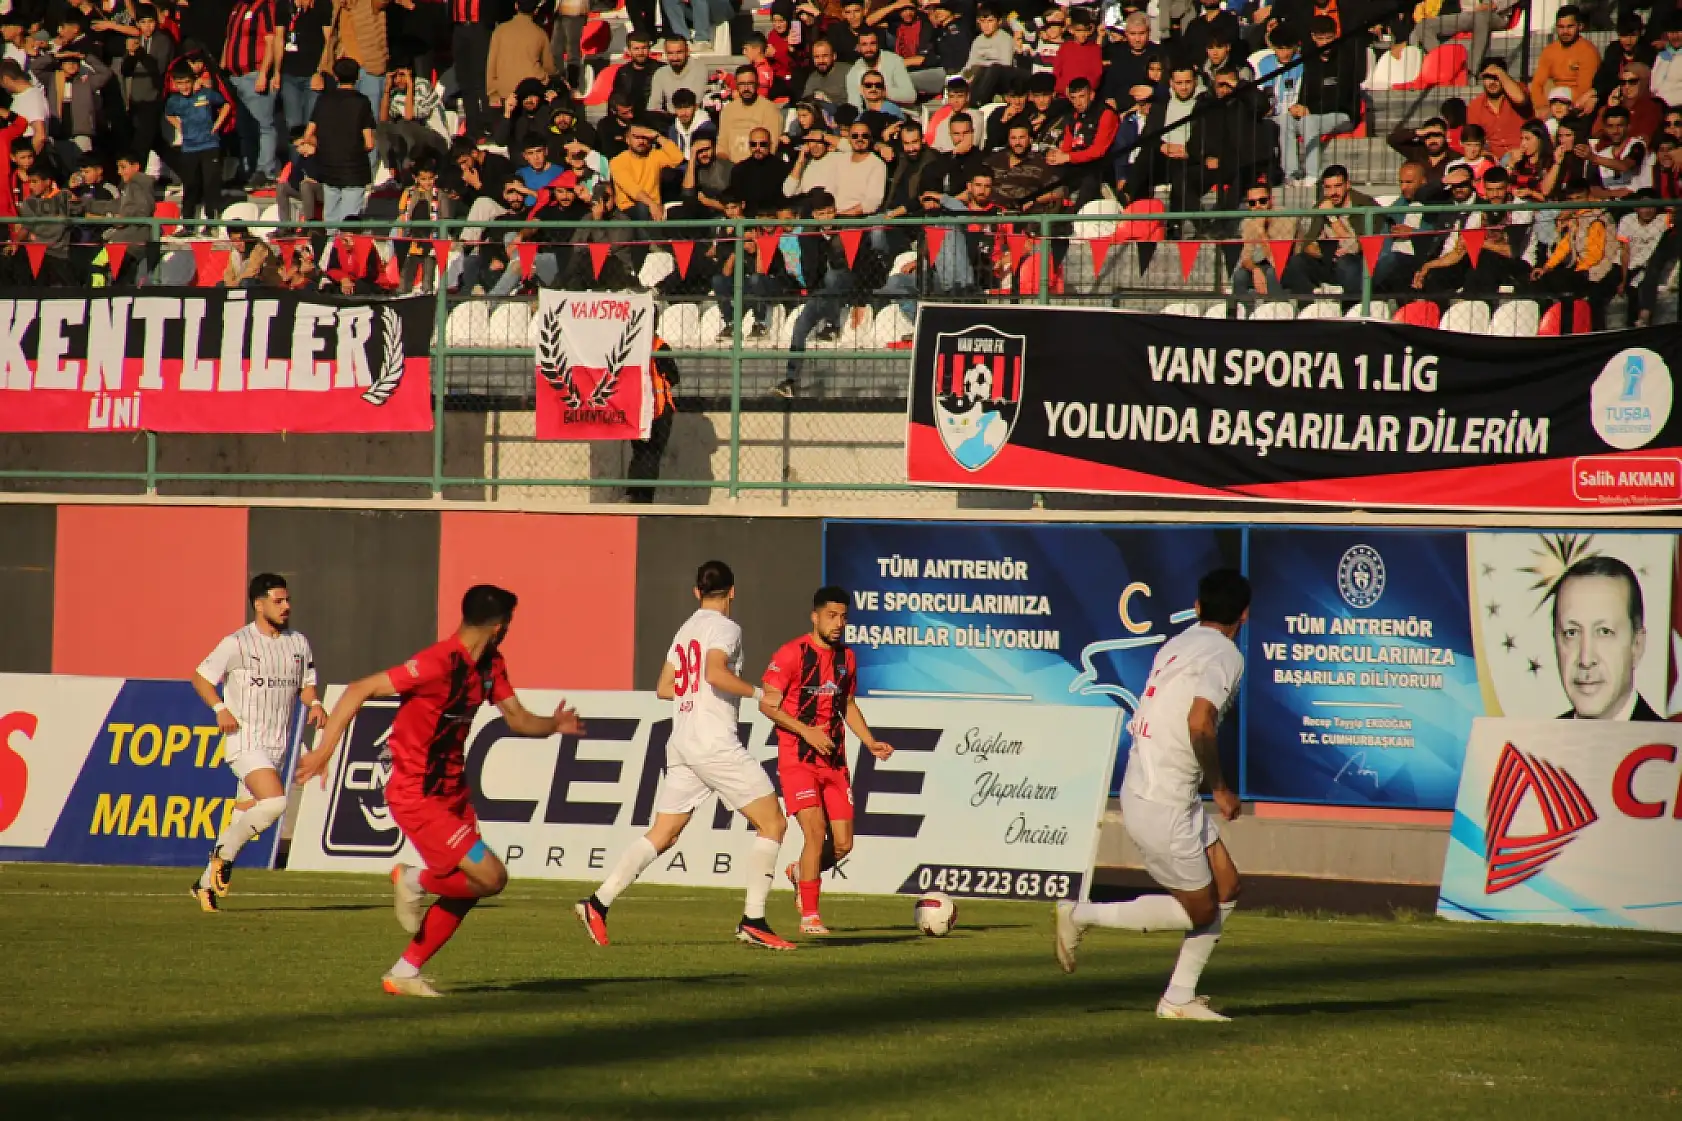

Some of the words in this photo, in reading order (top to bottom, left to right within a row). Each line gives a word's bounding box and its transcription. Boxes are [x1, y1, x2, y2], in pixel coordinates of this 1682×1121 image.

[1147, 345, 1216, 385] VAN
[1223, 348, 1344, 390] SPOR'A
[1354, 346, 1440, 393] 1.LİG
[87, 391, 142, 430] ÜNİ
[1605, 406, 1652, 422] TUŞBA
[1043, 401, 1200, 445] YOLUNDA
[1207, 408, 1402, 457] BAŞARILAR
[1405, 407, 1551, 455] DİLERİM
[1578, 470, 1616, 487] Salih
[1618, 471, 1675, 488] AKMAN
[877, 554, 918, 578] TÜM
[923, 557, 1029, 581] ANTRENÖR
[854, 590, 881, 611] VE
[883, 591, 1052, 616] SPORCULARIMIZA
[844, 624, 950, 649] BAŞARILAR
[955, 623, 1060, 650] DİLİYORUM
[1284, 613, 1325, 635] TÜM
[1329, 615, 1433, 638] ANTRENÖR
[1262, 643, 1287, 661] VE
[1292, 644, 1456, 666] SPORCULARIMIZA
[1274, 669, 1356, 688] BAŞARILAR
[1359, 670, 1444, 689] DİLİYORUM
[955, 726, 1025, 763] Sağlam
[1299, 732, 1320, 745] T.C.
[970, 770, 1059, 808] Yapıların
[1611, 743, 1682, 820] C
[1004, 811, 1069, 846] Öncüsü
[918, 867, 931, 890] 0
[934, 868, 971, 894] 432
[976, 870, 1011, 895] 223
[1015, 872, 1041, 897] 63
[1044, 874, 1070, 899] 63
